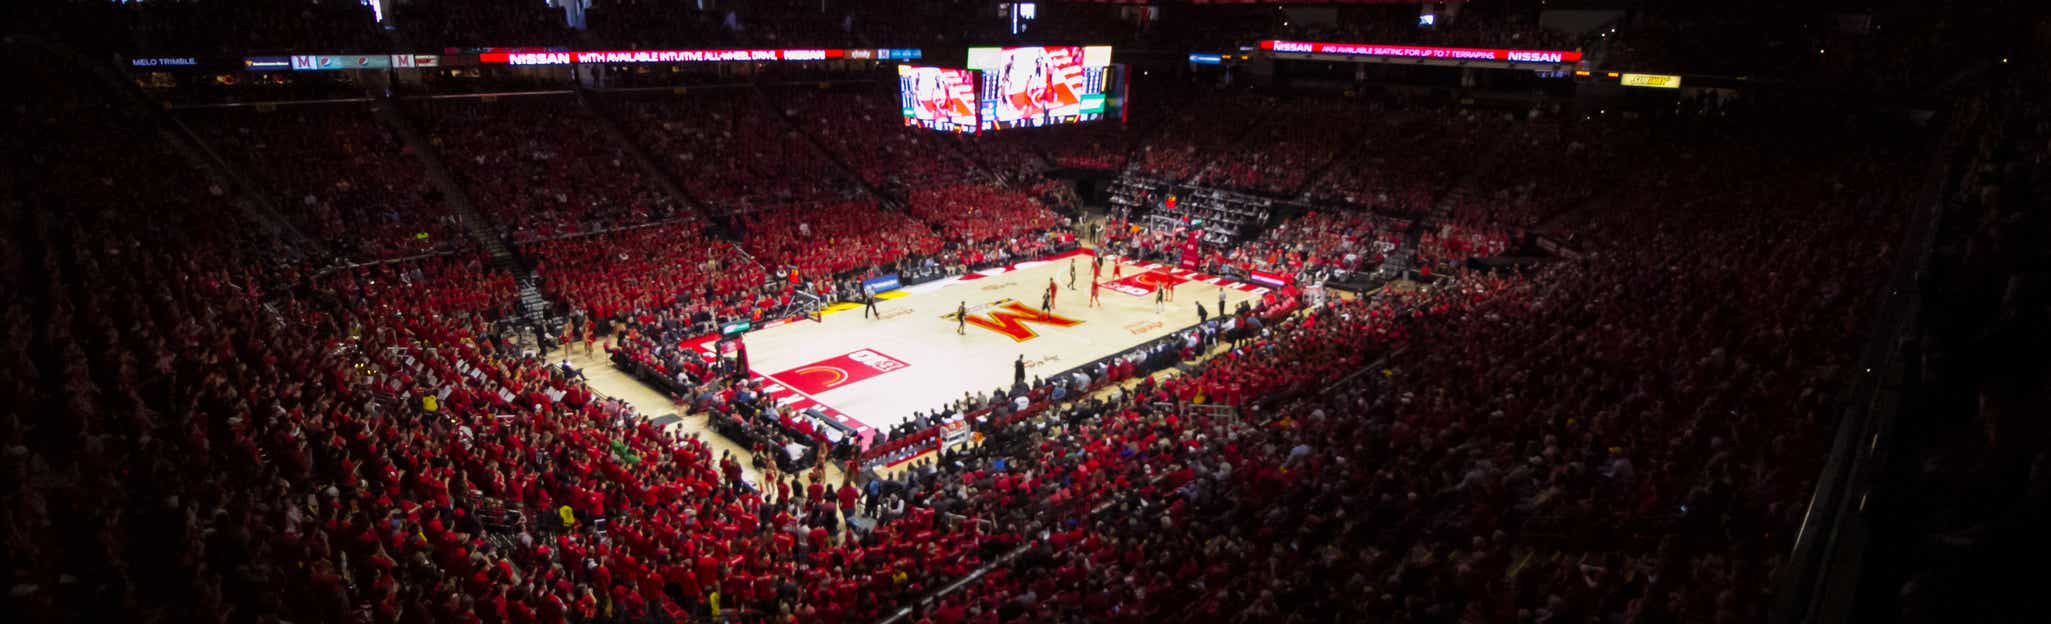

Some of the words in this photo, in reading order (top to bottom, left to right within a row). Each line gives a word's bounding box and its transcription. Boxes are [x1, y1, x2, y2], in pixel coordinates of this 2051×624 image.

[509, 53, 570, 64] NISSAN
[577, 53, 606, 62] WITH
[607, 52, 659, 62] AVAILABLE
[660, 51, 703, 61] INTUITIVE
[1273, 42, 1313, 52] NISSAN
[1337, 47, 1373, 55] AVAILABLE
[1374, 47, 1404, 56] SEATING
[1507, 52, 1562, 62] NISSAN
[132, 58, 158, 66] MELO
